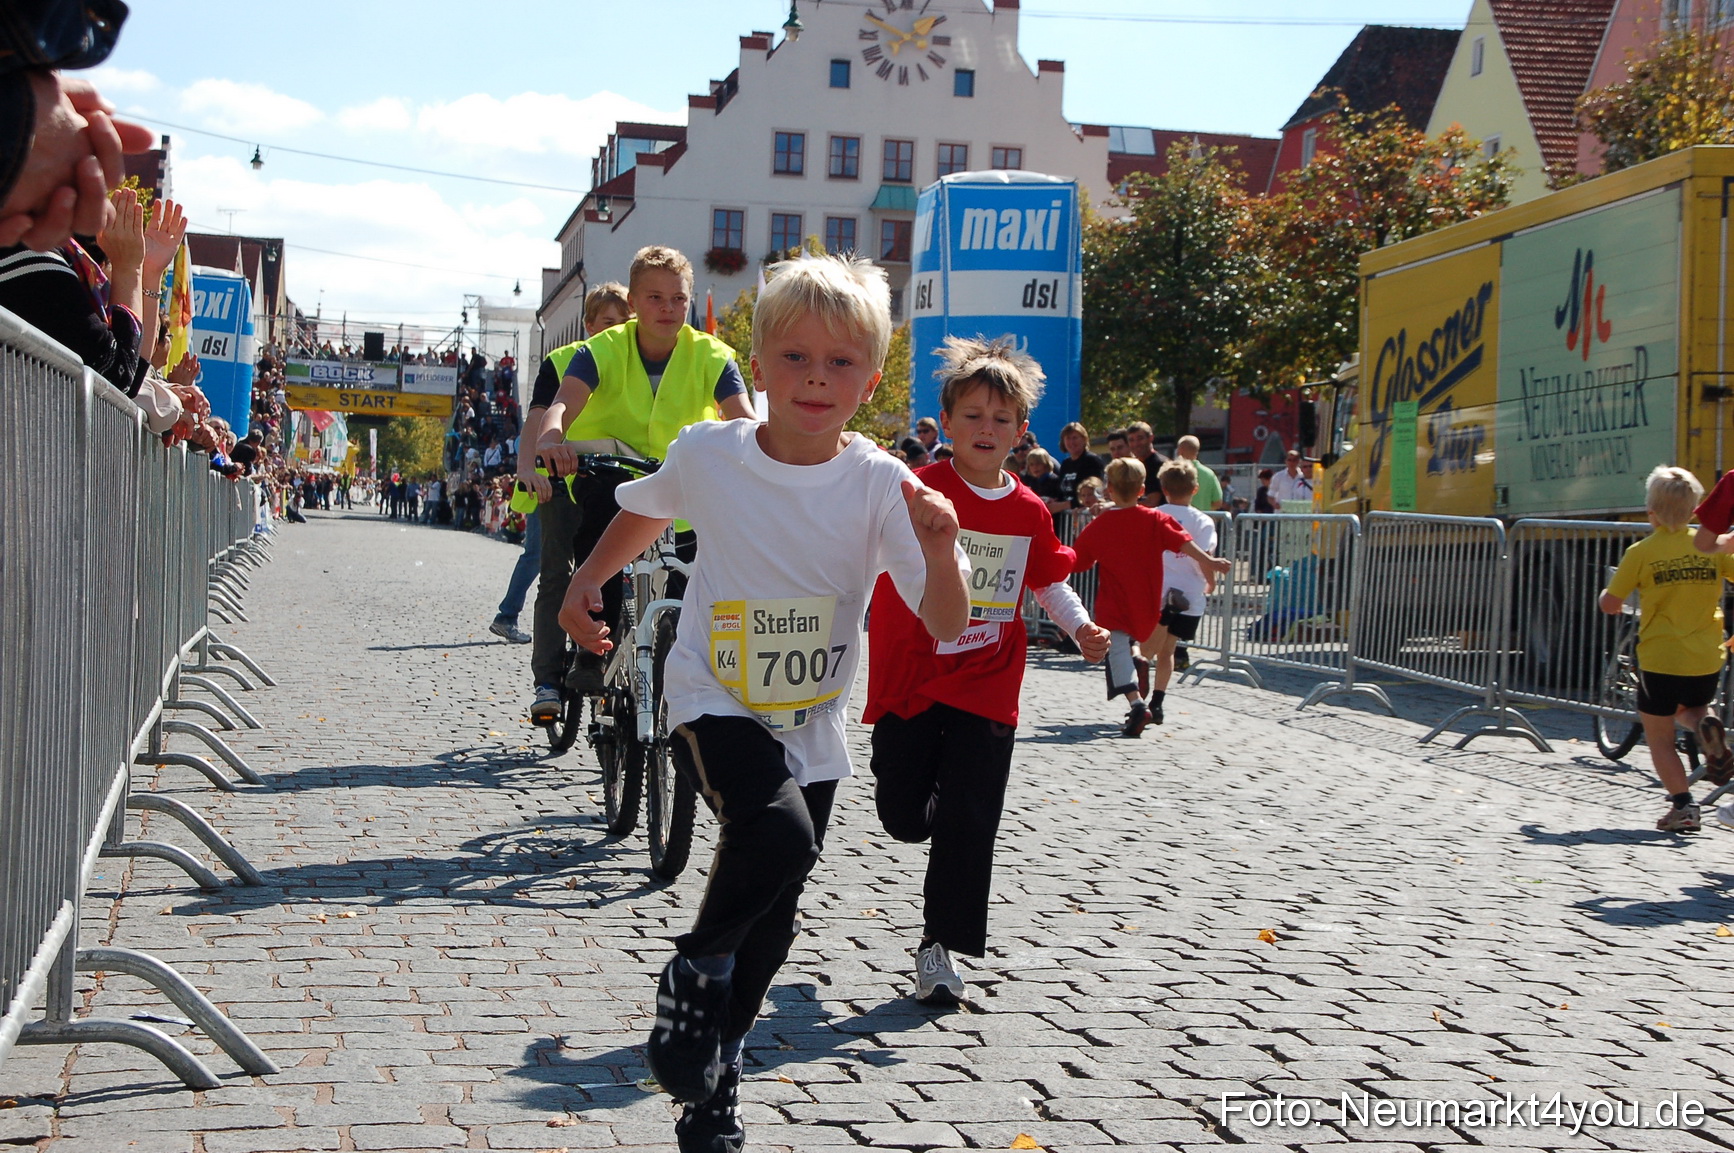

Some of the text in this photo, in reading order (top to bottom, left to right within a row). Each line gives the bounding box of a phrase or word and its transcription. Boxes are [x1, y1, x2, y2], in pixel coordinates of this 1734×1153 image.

[960, 200, 1062, 250] maxi
[166, 287, 235, 320] axi
[1022, 278, 1059, 309] dsl
[201, 335, 228, 357] dsl
[340, 392, 397, 409] START
[960, 536, 1003, 558] Florian
[753, 608, 819, 634] Stefan
[983, 607, 1014, 616] PFLEIDERER
[957, 631, 987, 646] DEHN
[717, 650, 737, 669] K4
[757, 644, 848, 687] 7007
